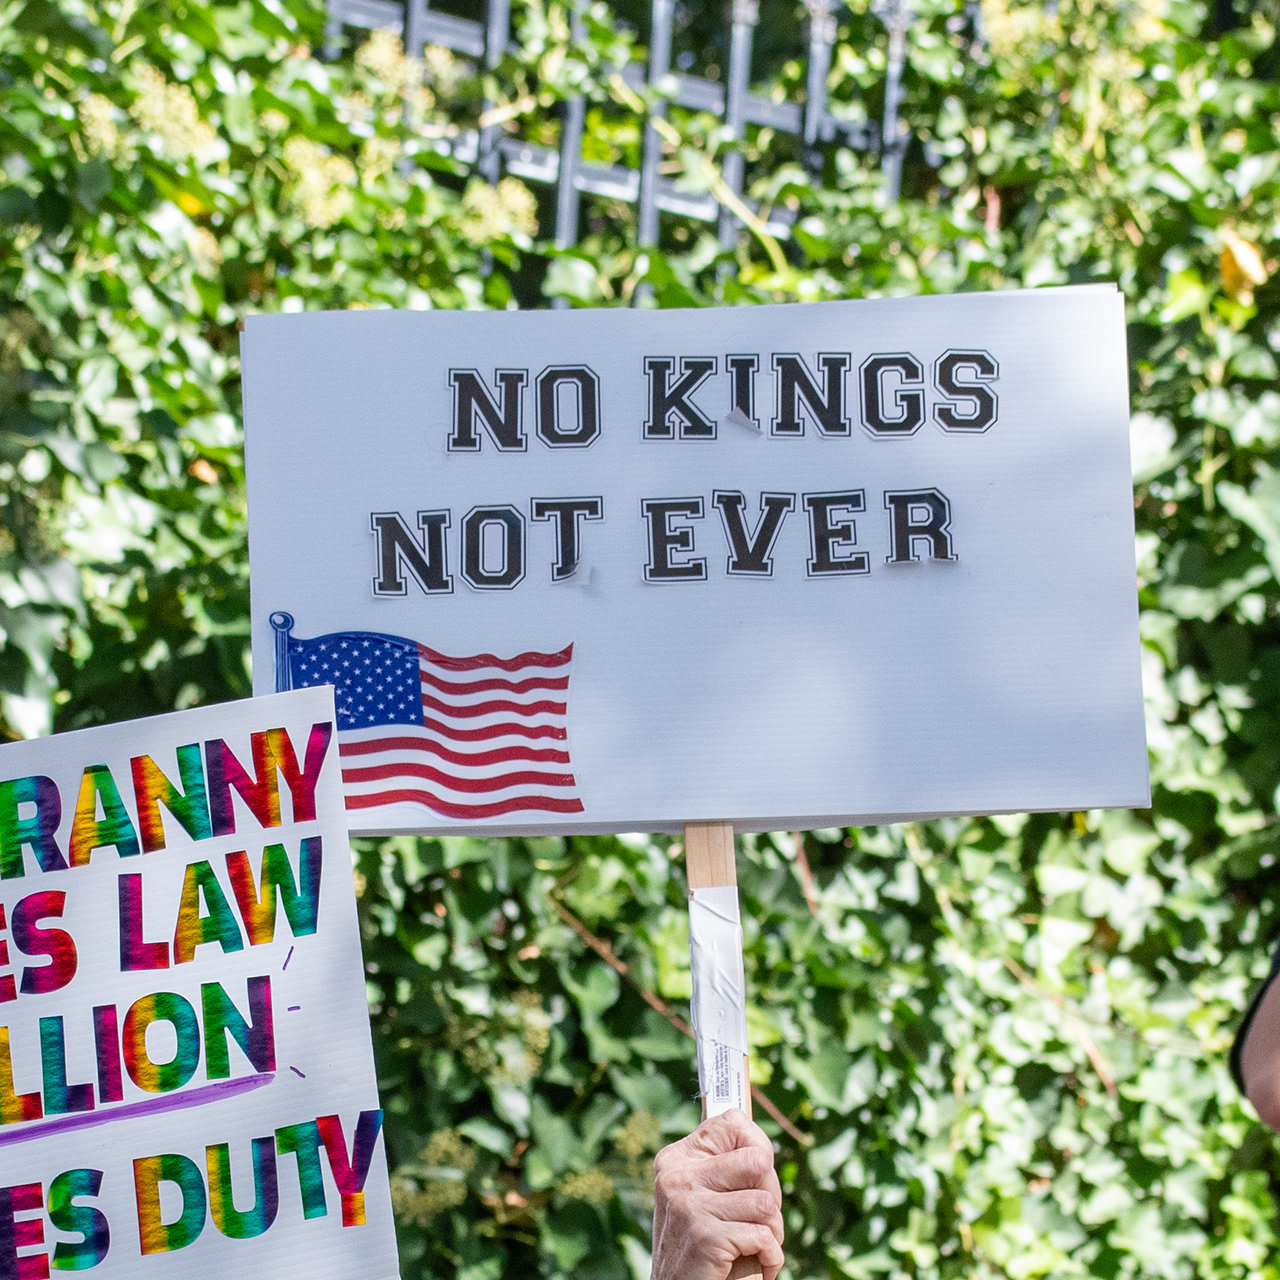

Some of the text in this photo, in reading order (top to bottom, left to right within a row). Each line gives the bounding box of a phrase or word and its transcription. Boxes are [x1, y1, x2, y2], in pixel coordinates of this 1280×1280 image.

[447, 348, 1001, 453] NO KINGS
[370, 487, 960, 597] NOT EVER
[118, 836, 322, 973] LAW
[132, 1108, 384, 1257] DUTY
